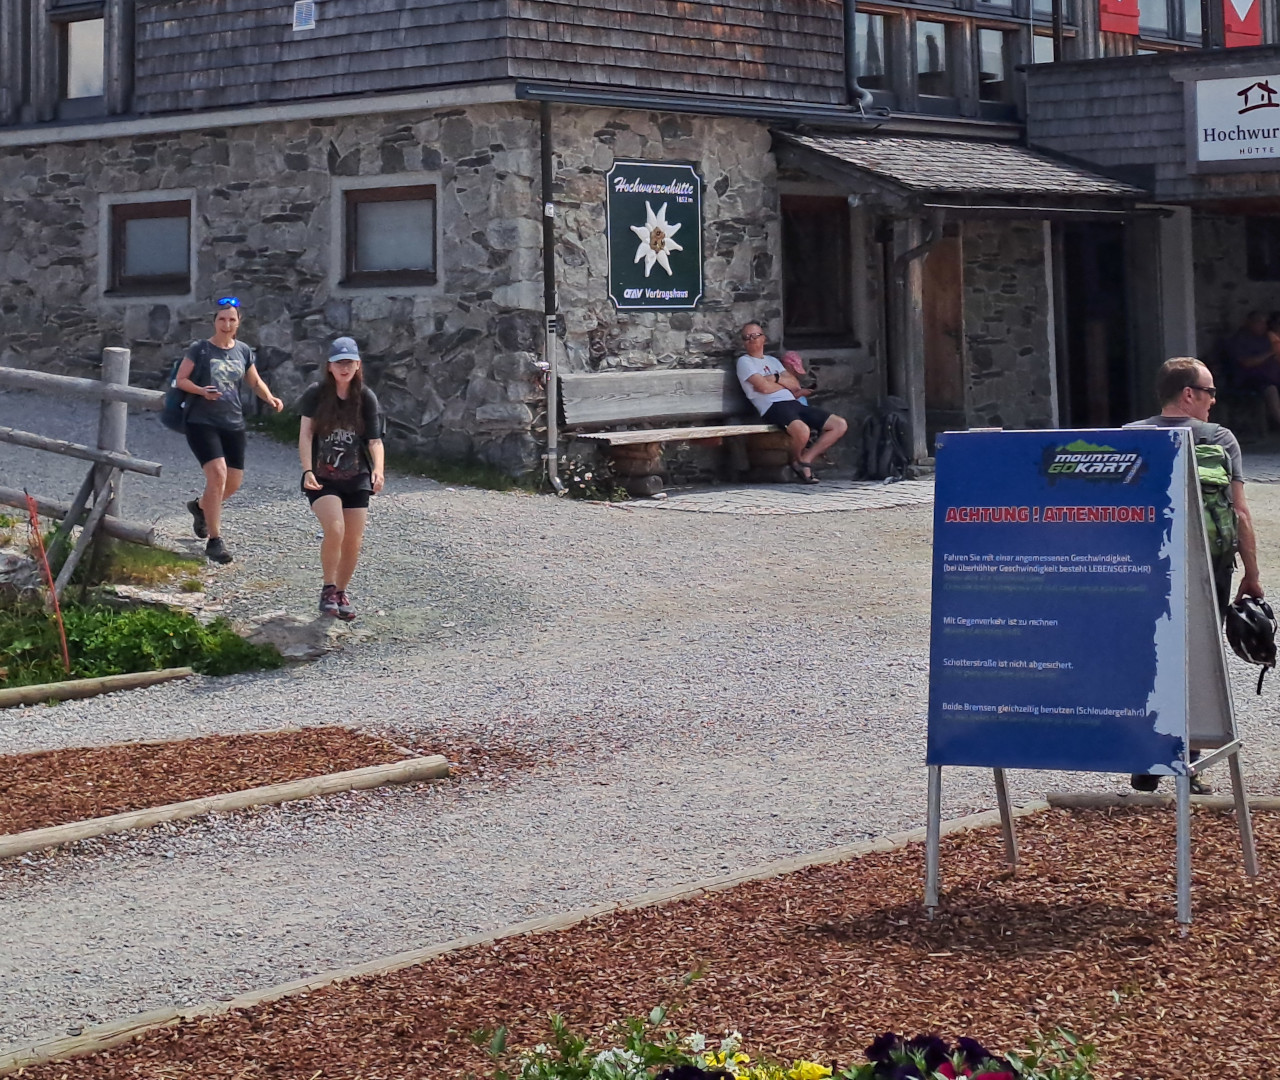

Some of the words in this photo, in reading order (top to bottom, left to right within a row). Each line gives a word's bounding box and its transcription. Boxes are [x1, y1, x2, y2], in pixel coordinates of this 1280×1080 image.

[1239, 146, 1275, 155] HÜTTE
[613, 177, 694, 195] Hochwurzenhütte
[645, 288, 689, 300] Vertragshaus
[1054, 453, 1138, 462] MOUNTAIN
[1047, 462, 1132, 473] GOKART
[945, 506, 1030, 523] ACHTUNG
[1032, 506, 1039, 522] !
[1043, 506, 1145, 522] ATTENTION
[1148, 506, 1156, 522] !
[943, 553, 968, 561] Fahren
[969, 553, 980, 561] Sie
[982, 553, 994, 561] mit
[1015, 554, 1069, 564] angemessenen
[1070, 554, 1133, 564] Geschwindigkeit.
[943, 563, 956, 572] (bei
[999, 564, 1058, 574] Geschwindigkeit
[1060, 564, 1087, 573] besteht
[1088, 565, 1152, 574] LEBENSGEFAHR)
[943, 617, 955, 625] Mit
[956, 617, 1006, 626] Gegenverkehr
[1008, 618, 1017, 626] ist
[1028, 618, 1058, 626] rechnen
[943, 658, 997, 667] Schotterstraße
[998, 659, 1008, 668] ist
[1009, 660, 1028, 668] nicht
[1028, 661, 1074, 670] abgesichert.
[942, 702, 963, 711] Beide
[963, 703, 996, 711] Bremsen
[997, 704, 1039, 715] gleichzeitig
[1040, 705, 1075, 714] benutzen
